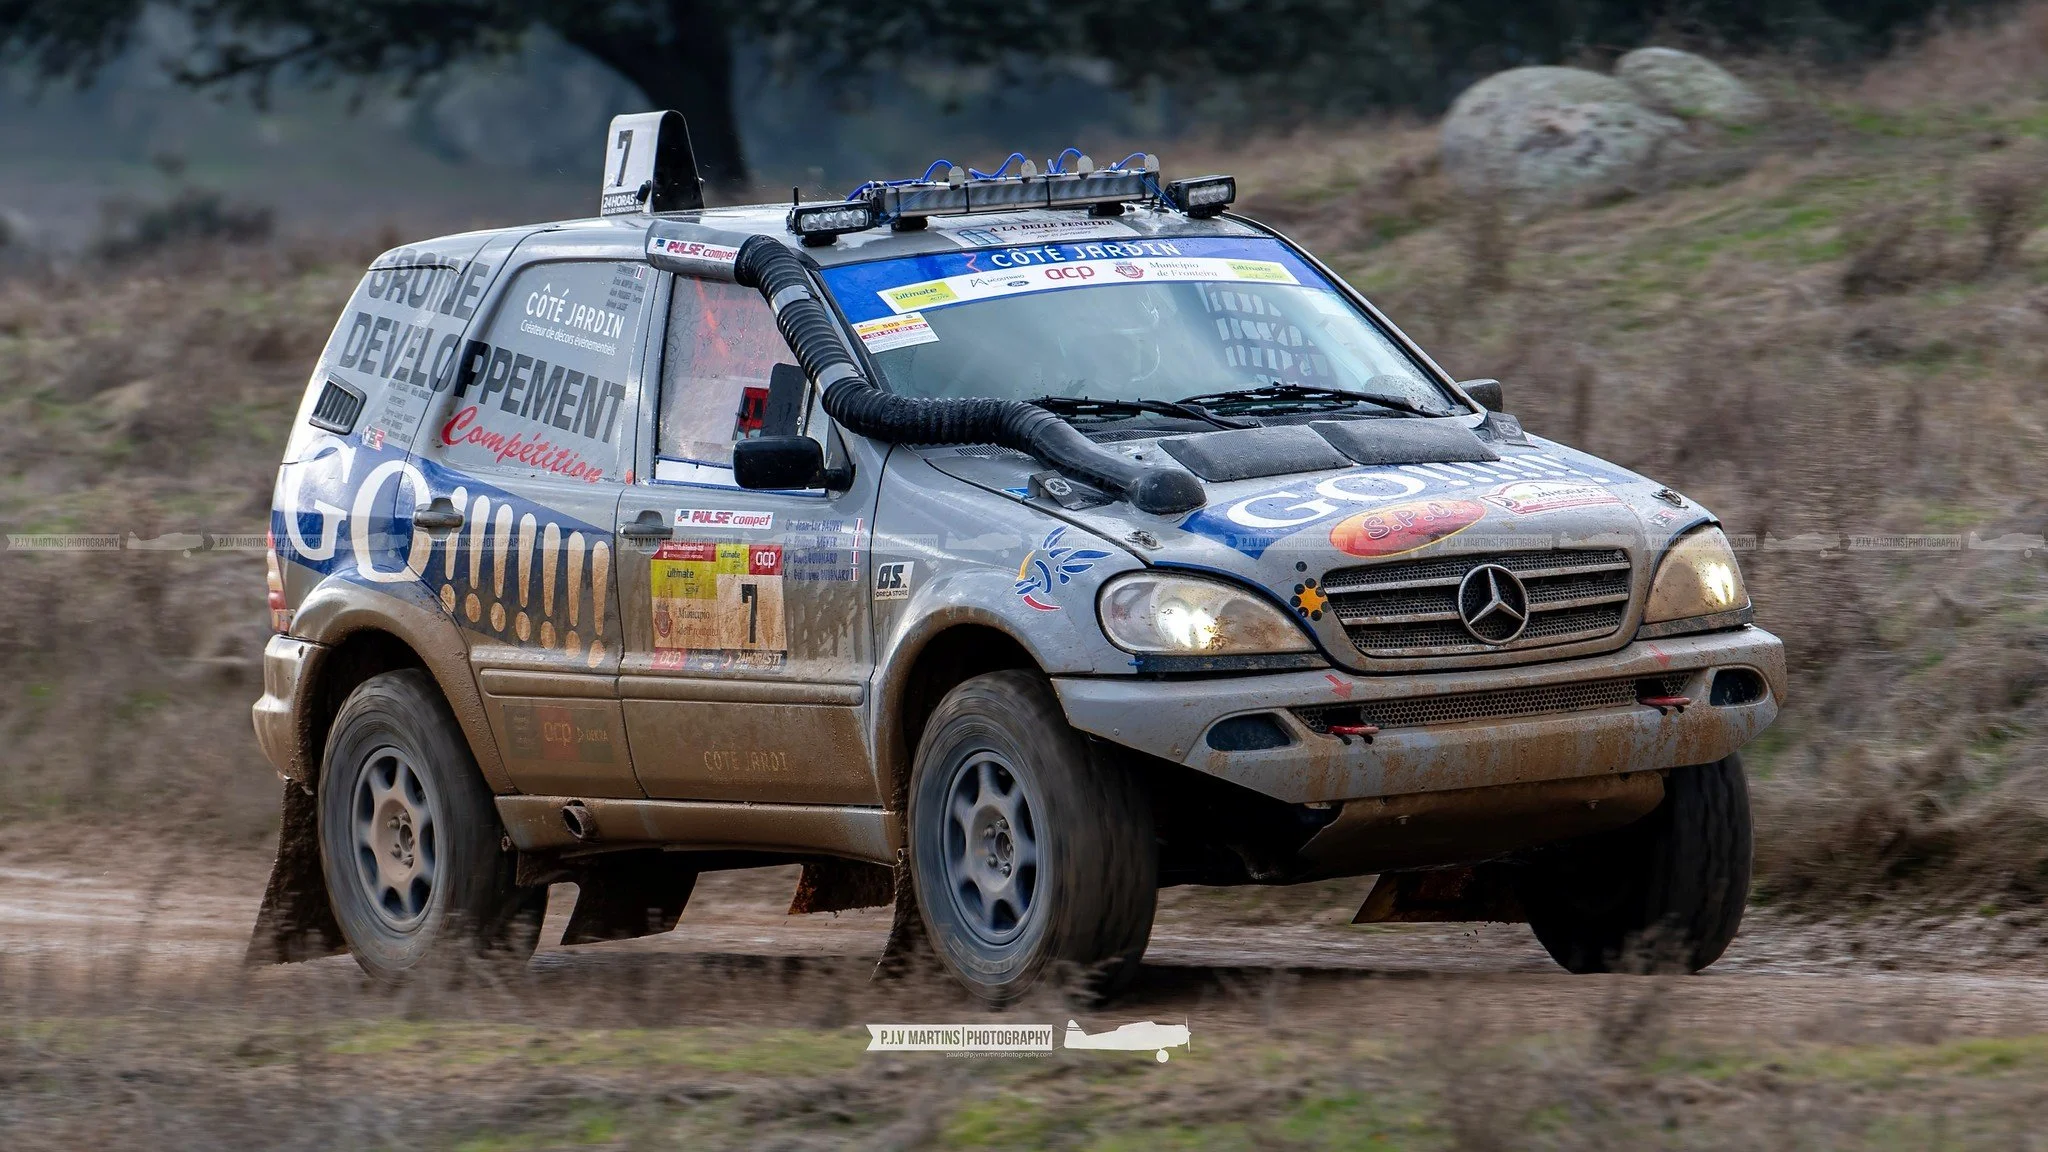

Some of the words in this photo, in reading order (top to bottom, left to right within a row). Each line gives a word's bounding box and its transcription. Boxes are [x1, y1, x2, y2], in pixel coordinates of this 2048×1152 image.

[617, 129, 634, 187] 7
[1002, 224, 1017, 232] LA
[1021, 222, 1058, 230] BELLE
[667, 241, 705, 256] PULSE
[702, 247, 738, 261] compet
[991, 245, 1066, 267] CÔTÉ
[1076, 242, 1182, 259] JARDIN
[1045, 266, 1095, 281] acp
[1150, 261, 1199, 270] Município
[1157, 269, 1168, 277] de
[1171, 269, 1218, 278] Fronteira
[526, 283, 570, 323] CÔTÉ
[565, 303, 625, 339] JARDIN
[520, 320, 546, 338] Créateur
[546, 326, 555, 339] de
[554, 329, 574, 345] décors
[338, 312, 628, 445] DEVELOPPEMENT
[440, 406, 603, 484] Compétition
[692, 510, 733, 525] PULSE
[733, 515, 771, 527] compet
[755, 551, 776, 569] acp
[666, 567, 694, 579] ultimate
[876, 590, 892, 598] ORECA
[892, 589, 908, 597] STORE
[741, 584, 758, 643] 7
